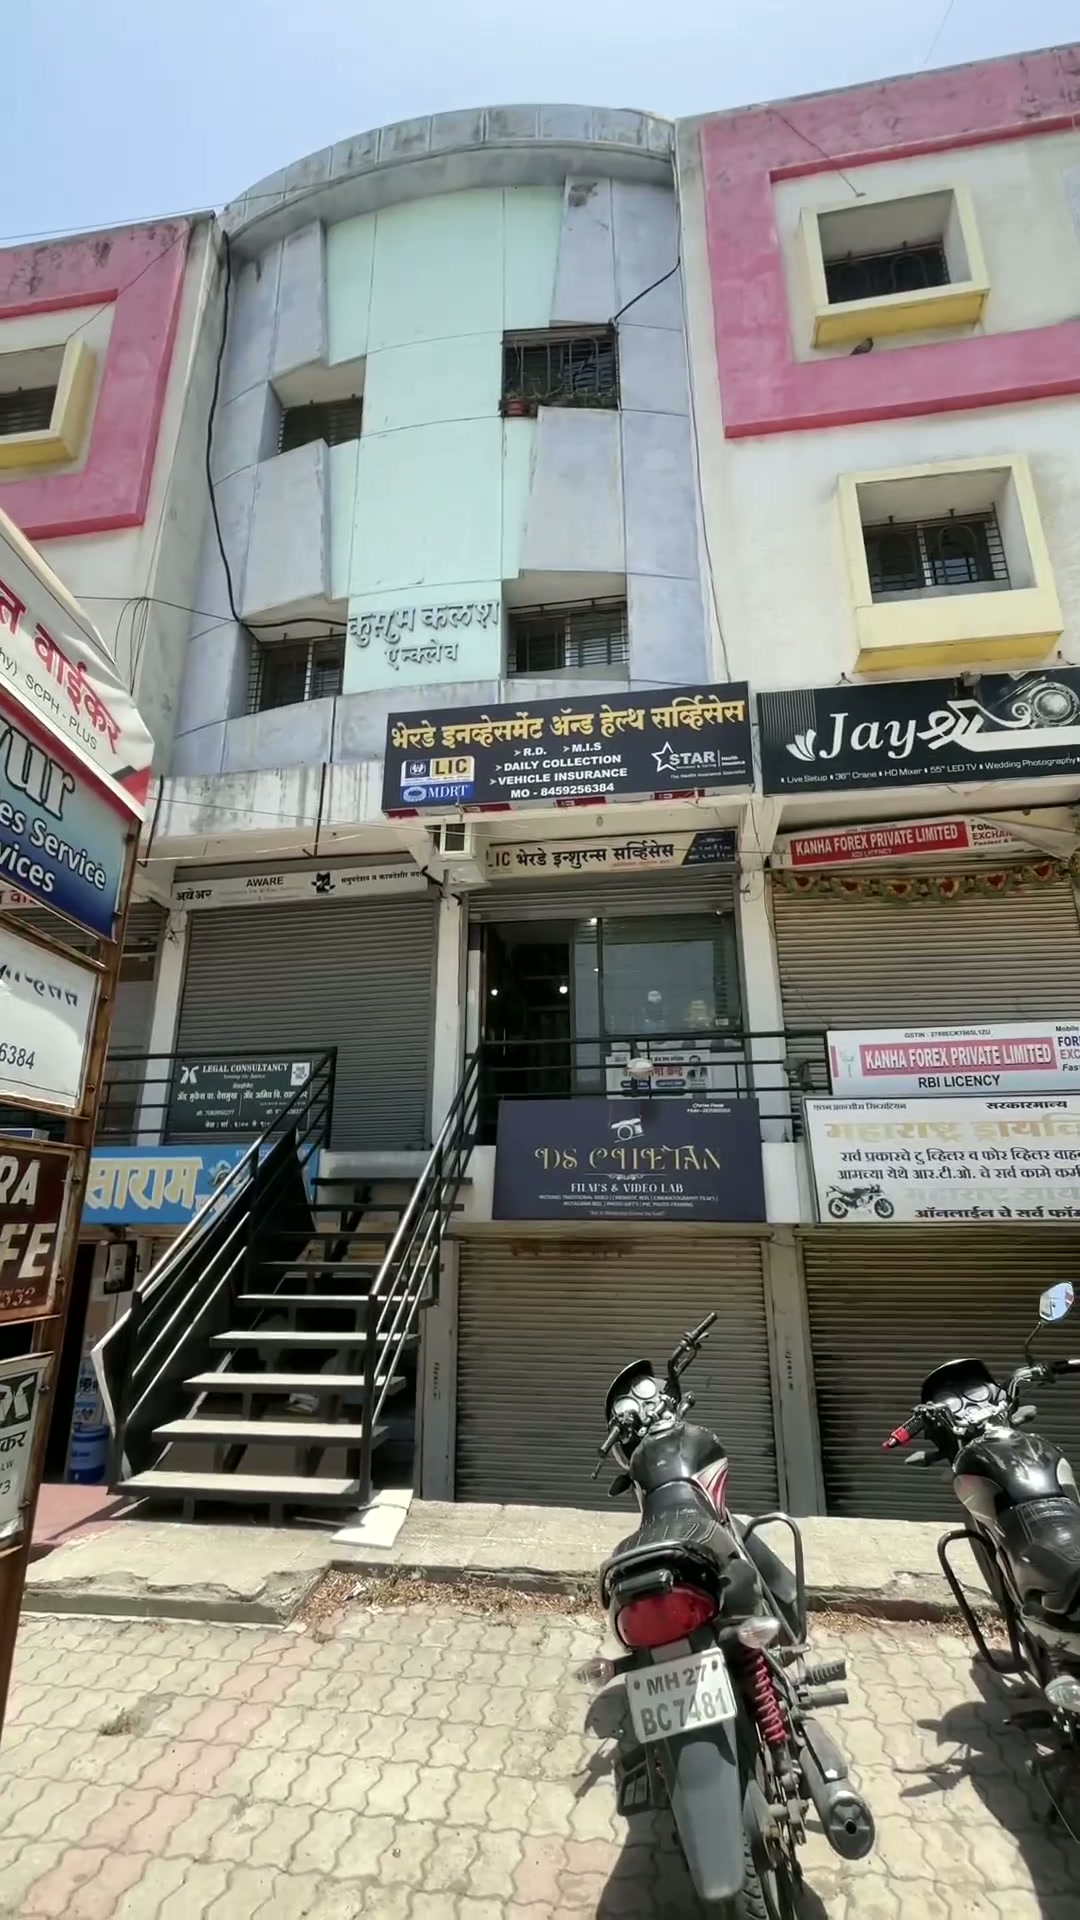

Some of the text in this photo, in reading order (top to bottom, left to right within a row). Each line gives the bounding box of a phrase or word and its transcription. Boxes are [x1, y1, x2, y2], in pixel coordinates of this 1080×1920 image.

[421, 602, 499, 630] कलश
[25, 674, 61, 715] SCPH
[69, 718, 98, 750] PLUS
[391, 719, 437, 749] भेरडे
[600, 704, 646, 738] हेल्थ
[651, 694, 746, 731] सर्व्हिसेस
[818, 711, 917, 760] Jay
[523, 747, 547, 757] R.D.
[571, 742, 602, 753] M.I.S
[435, 758, 468, 775] LIC
[504, 755, 622, 772] DAILY COLLECTION
[669, 751, 717, 766] STAR
[498, 767, 629, 786] VEHICLE INSURANCE
[786, 776, 802, 784] Live
[803, 775, 828, 783] Setup
[852, 771, 877, 780] Crane
[884, 769, 898, 777] HD
[899, 768, 922, 777] Mixer
[947, 764, 965, 773] LED
[966, 763, 977, 771] TV
[985, 759, 1021, 770] Wedding
[1022, 756, 1076, 767] Photography
[428, 784, 467, 799] MDRT
[510, 789, 531, 799] MO
[540, 782, 615, 797] 8459256384
[795, 838, 833, 857] KANHA
[834, 833, 869, 853] FOREX
[870, 828, 915, 848] PRIVATE
[917, 824, 959, 842] LIMITED
[30, 817, 107, 890] Service
[516, 848, 547, 866] भेरडे
[552, 849, 608, 869] इन्शुरन्स
[611, 839, 674, 861] सर्व्हिसेस
[246, 876, 284, 887] AWARE
[865, 1042, 1052, 1070] KANHA FOREX PRIVATE LIMITED
[202, 1062, 288, 1073] LEGAL CONSULTANCY
[918, 1074, 1001, 1089] RBI LICENCY
[985, 1100, 1068, 1110] सरकारमान्य
[535, 1147, 578, 1170] DS
[864, 1147, 911, 1162] प्रकारचे
[968, 1150, 978, 1161] व
[981, 1147, 1008, 1161] फोर
[838, 1169, 884, 1180] आमच्या
[886, 1166, 909, 1180] येथे
[1019, 1164, 1052, 1178] कामे
[611, 1183, 619, 1192] &
[623, 1183, 658, 1193] VIDEO
[661, 1183, 684, 1193] LAB
[915, 1206, 994, 1219] ऑनलाईन
[1015, 1206, 1044, 1218] सर्व
[646, 1664, 707, 1696] MH 27
[640, 1687, 729, 1737] BC 7481
